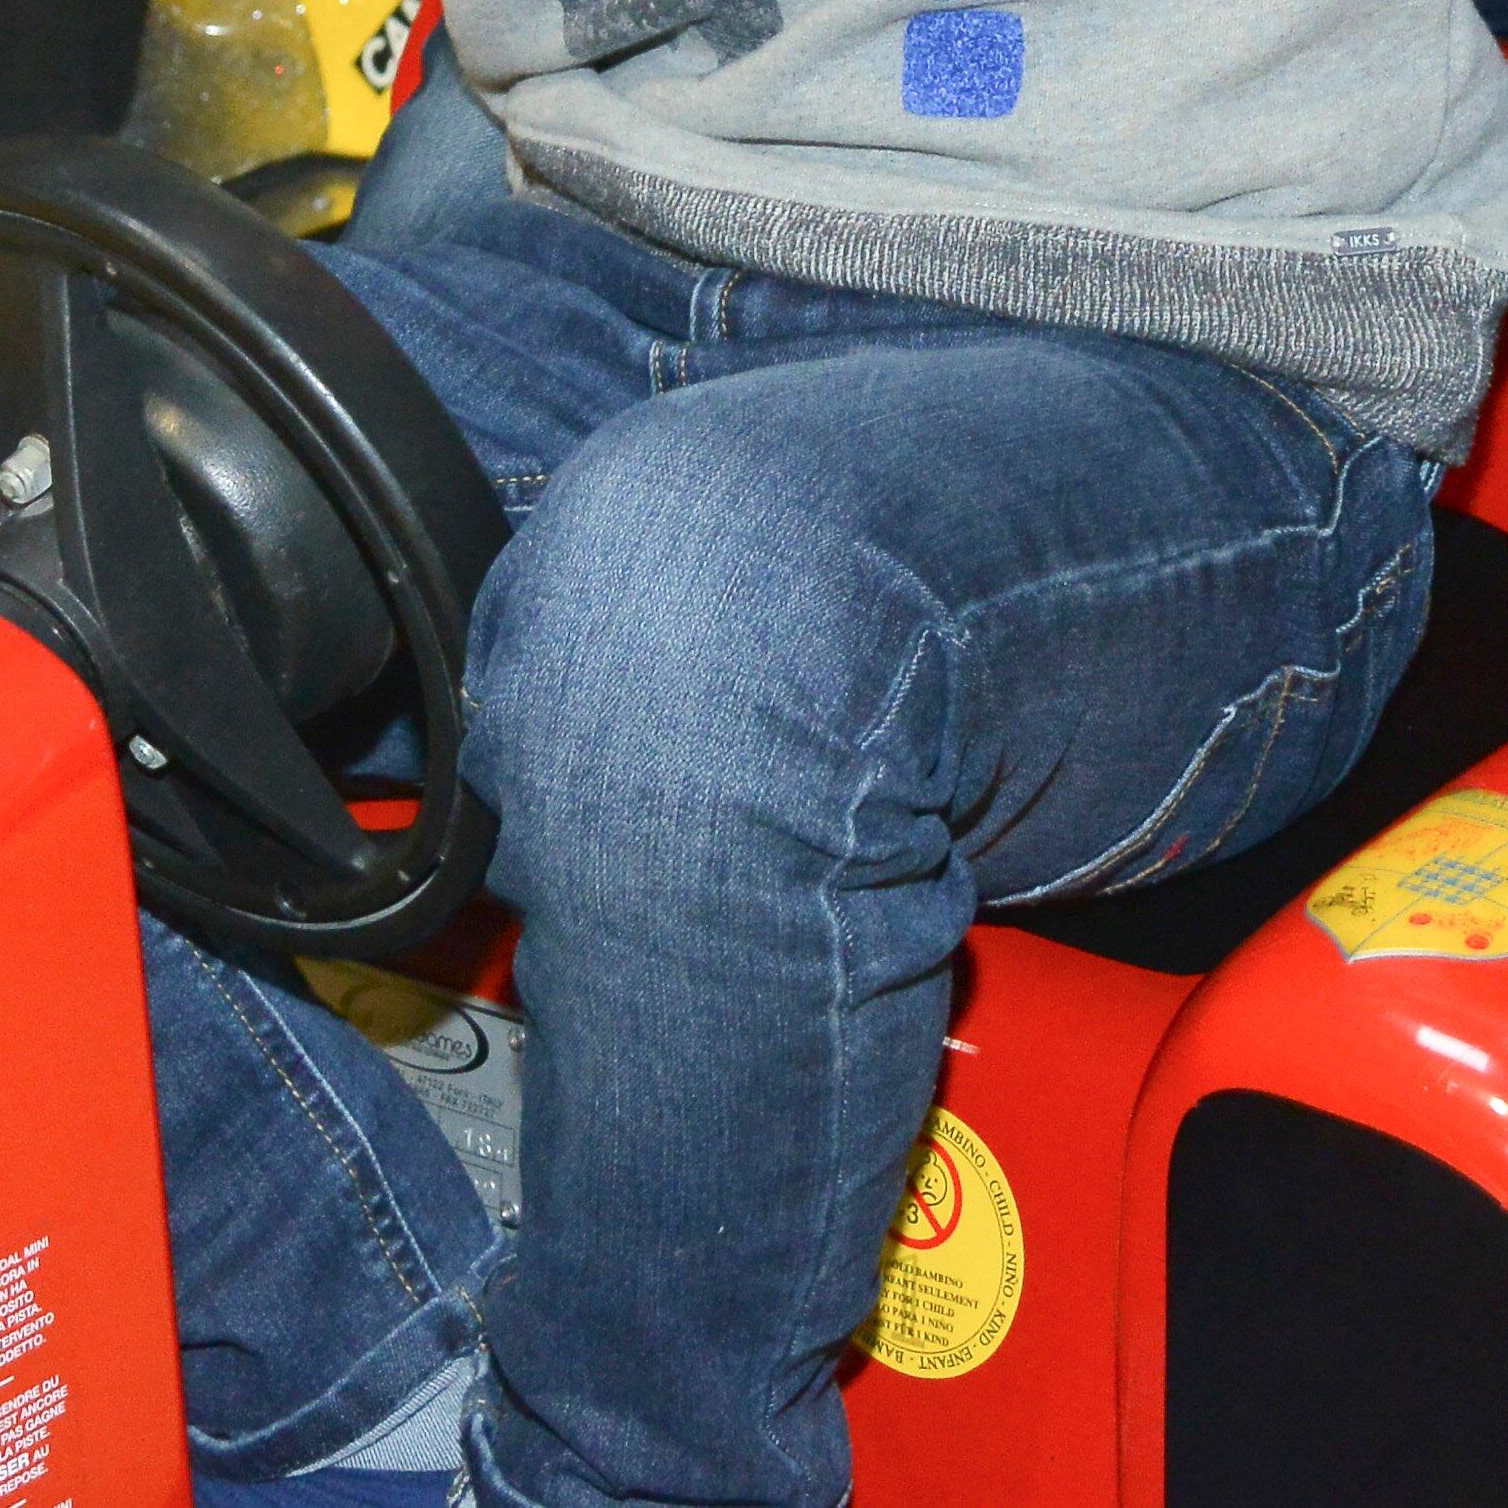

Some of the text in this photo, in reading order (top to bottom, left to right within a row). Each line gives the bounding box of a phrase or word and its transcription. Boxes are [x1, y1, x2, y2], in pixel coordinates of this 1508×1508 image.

[1349, 233, 1380, 249] IKKS
[931, 1116, 986, 1168] AMBINO
[989, 1179, 1015, 1237] CHILD
[23, 1236, 50, 1258] MINI
[27, 1257, 40, 1273] IN
[915, 1264, 964, 1289] BAMBINO
[10, 1279, 28, 1295] HA
[918, 1282, 980, 1309] SEULEMENT
[7, 1302, 43, 1328] PISTA.
[922, 1300, 955, 1318] CHILD
[923, 1329, 950, 1347] KIND
[979, 1309, 1007, 1346] KIND
[918, 1347, 973, 1370] ENFANT
[42, 1374, 60, 1394] DU
[20, 1384, 69, 1421] ANCORE
[0, 1425, 24, 1446] PAS
[25, 1400, 67, 1432] GAGNE
[32, 1444, 50, 1463] AU
